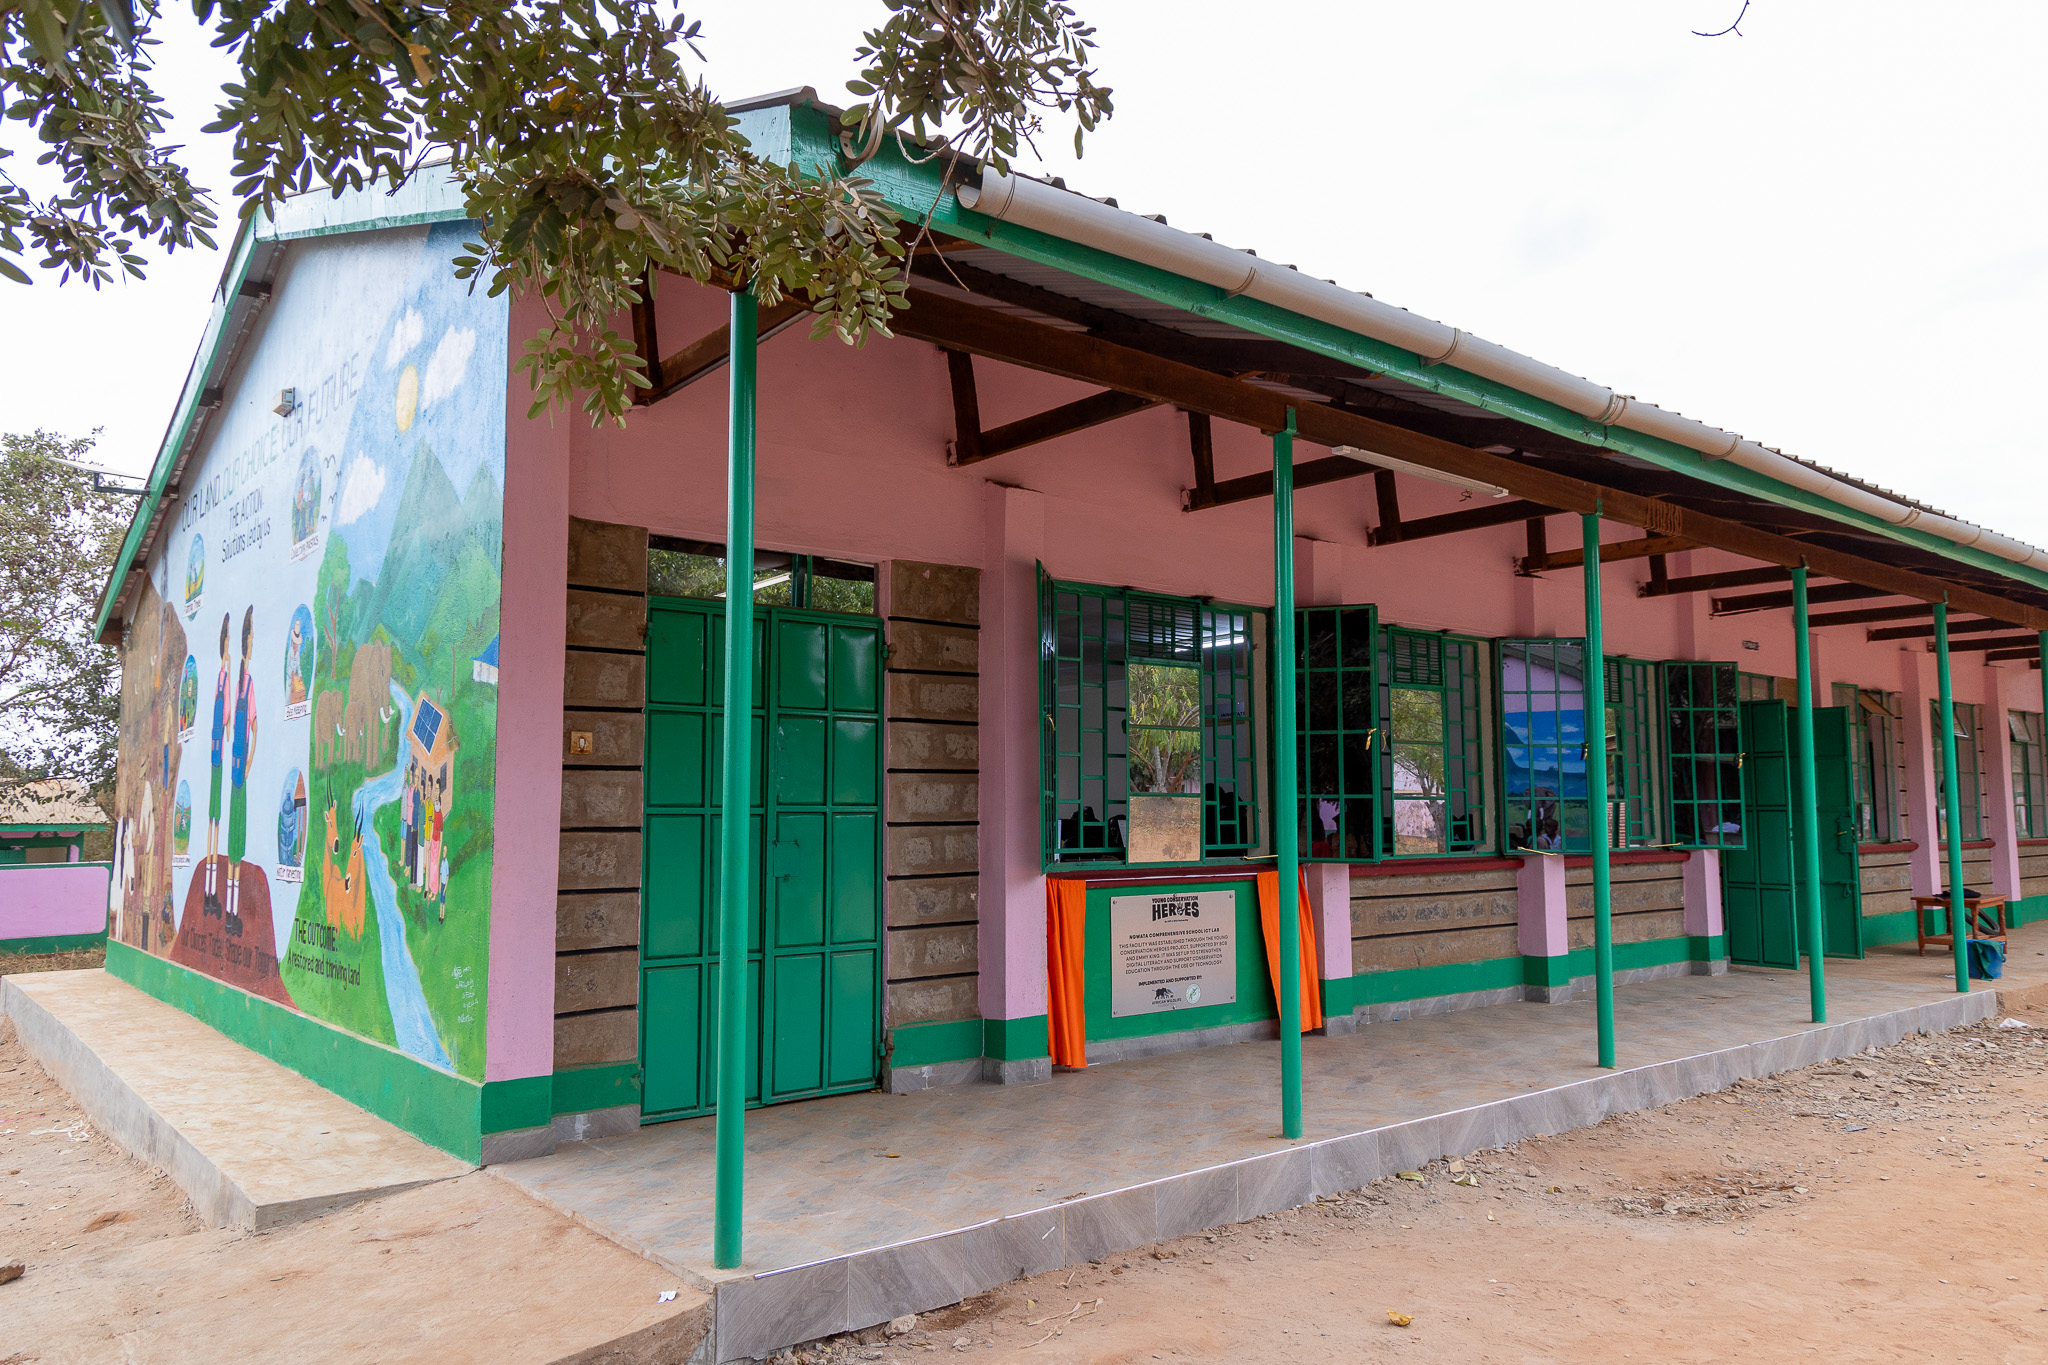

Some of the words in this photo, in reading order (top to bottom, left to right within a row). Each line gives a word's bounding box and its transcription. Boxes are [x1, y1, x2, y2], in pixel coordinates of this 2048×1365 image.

[182, 493, 198, 533] OUR
[223, 457, 240, 500] OUR
[230, 502, 240, 532] THE
[222, 532, 246, 563] Solutions
[264, 516, 270, 537] us
[1152, 901, 1199, 921] HEROES
[295, 918, 306, 944] THE
[307, 922, 338, 952] OUTCOME:
[292, 952, 314, 972] restored
[315, 954, 325, 975] and
[326, 958, 347, 990] thriving
[348, 963, 360, 986] land
